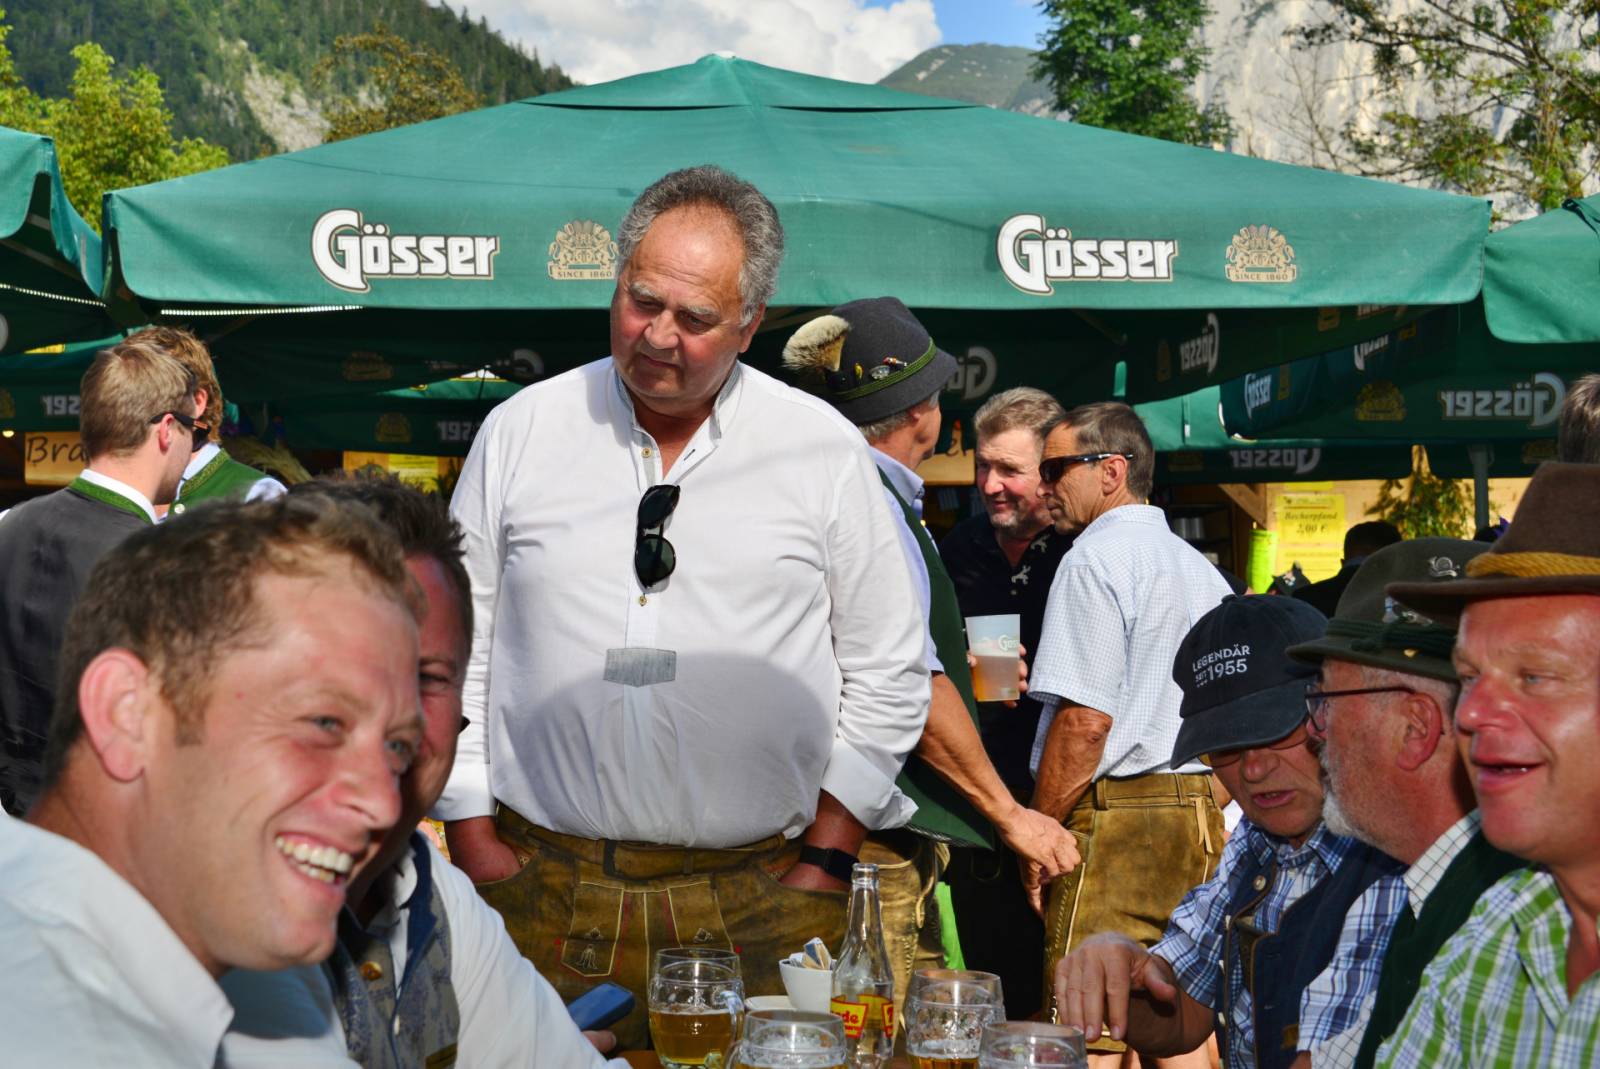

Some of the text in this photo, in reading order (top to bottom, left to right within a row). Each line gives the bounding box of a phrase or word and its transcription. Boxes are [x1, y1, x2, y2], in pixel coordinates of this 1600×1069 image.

[311, 208, 499, 292] Gösser
[997, 213, 1177, 294] Gösser
[1193, 644, 1250, 672] LEGENDÄR
[1207, 658, 1247, 680] 1955
